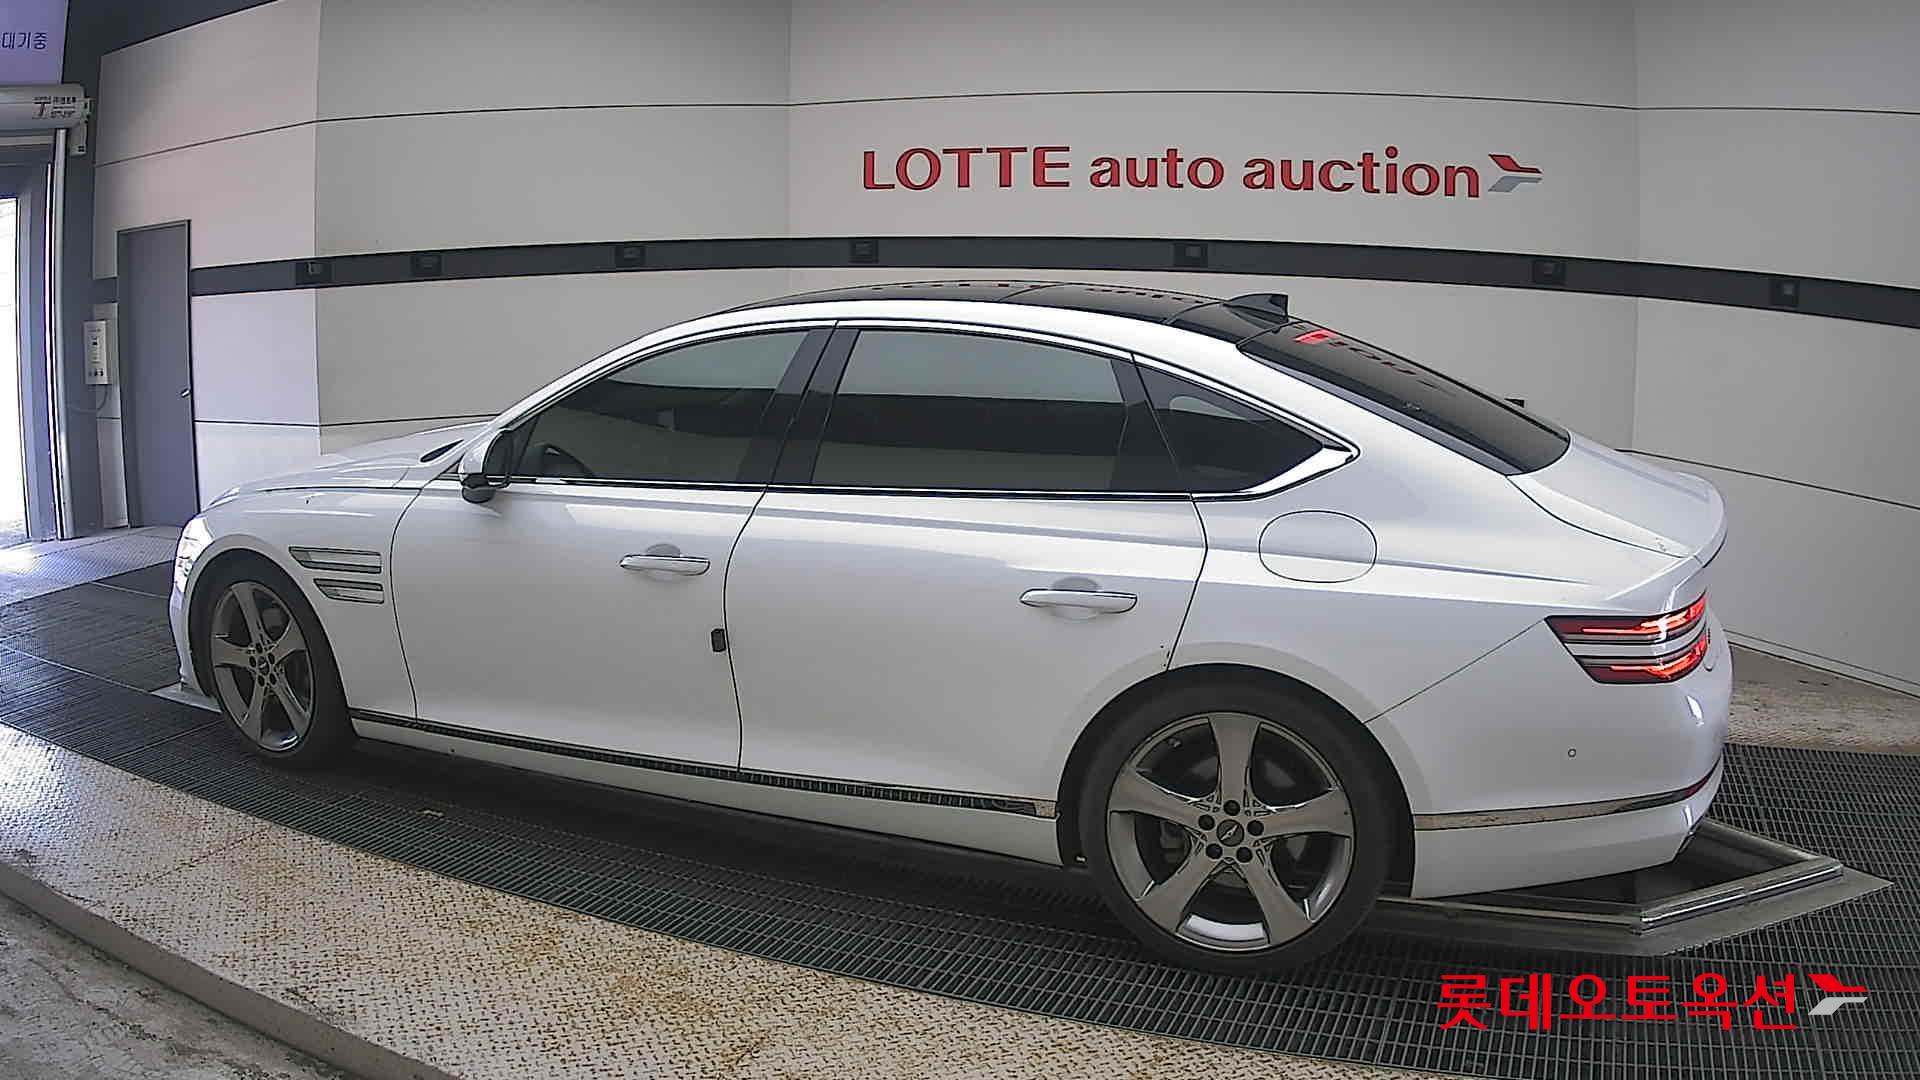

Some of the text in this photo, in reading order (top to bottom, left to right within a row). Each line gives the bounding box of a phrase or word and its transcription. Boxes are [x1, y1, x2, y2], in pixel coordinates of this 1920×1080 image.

[1, 31, 48, 50] 대기중
[862, 145, 1482, 198] LOTTE auto auction
